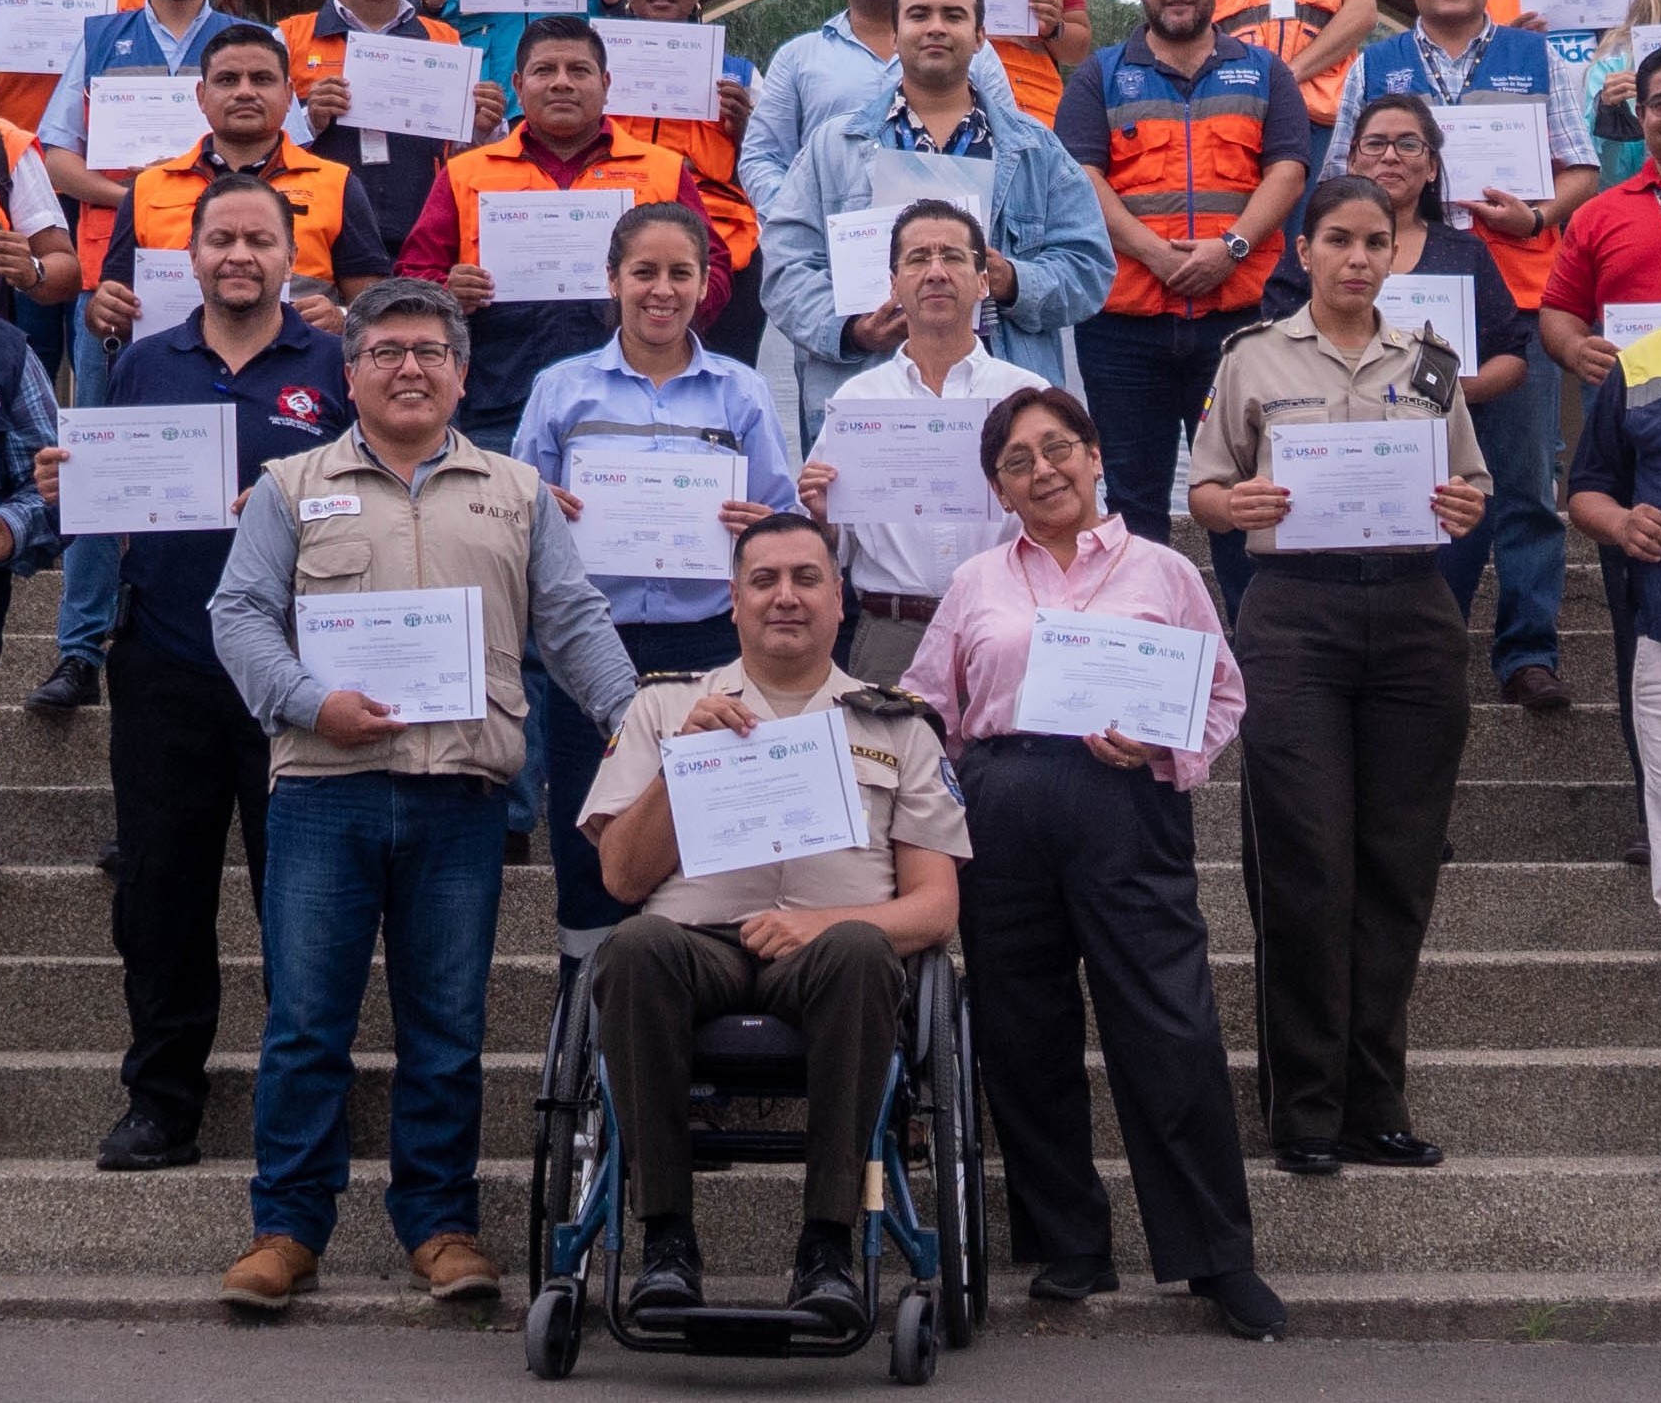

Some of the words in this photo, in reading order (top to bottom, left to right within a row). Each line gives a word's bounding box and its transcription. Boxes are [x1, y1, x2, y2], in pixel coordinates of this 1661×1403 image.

[498, 211, 529, 220] USAID
[849, 421, 882, 430] USAID
[82, 431, 115, 441] USAID
[1295, 446, 1328, 457] USAID
[594, 473, 627, 483] USAID
[323, 499, 352, 510] USAID
[487, 505, 522, 524] ADRA
[320, 618, 355, 629] USAID
[1056, 634, 1091, 645] USAID
[852, 746, 896, 767] LICIA
[688, 757, 721, 771] USAID
